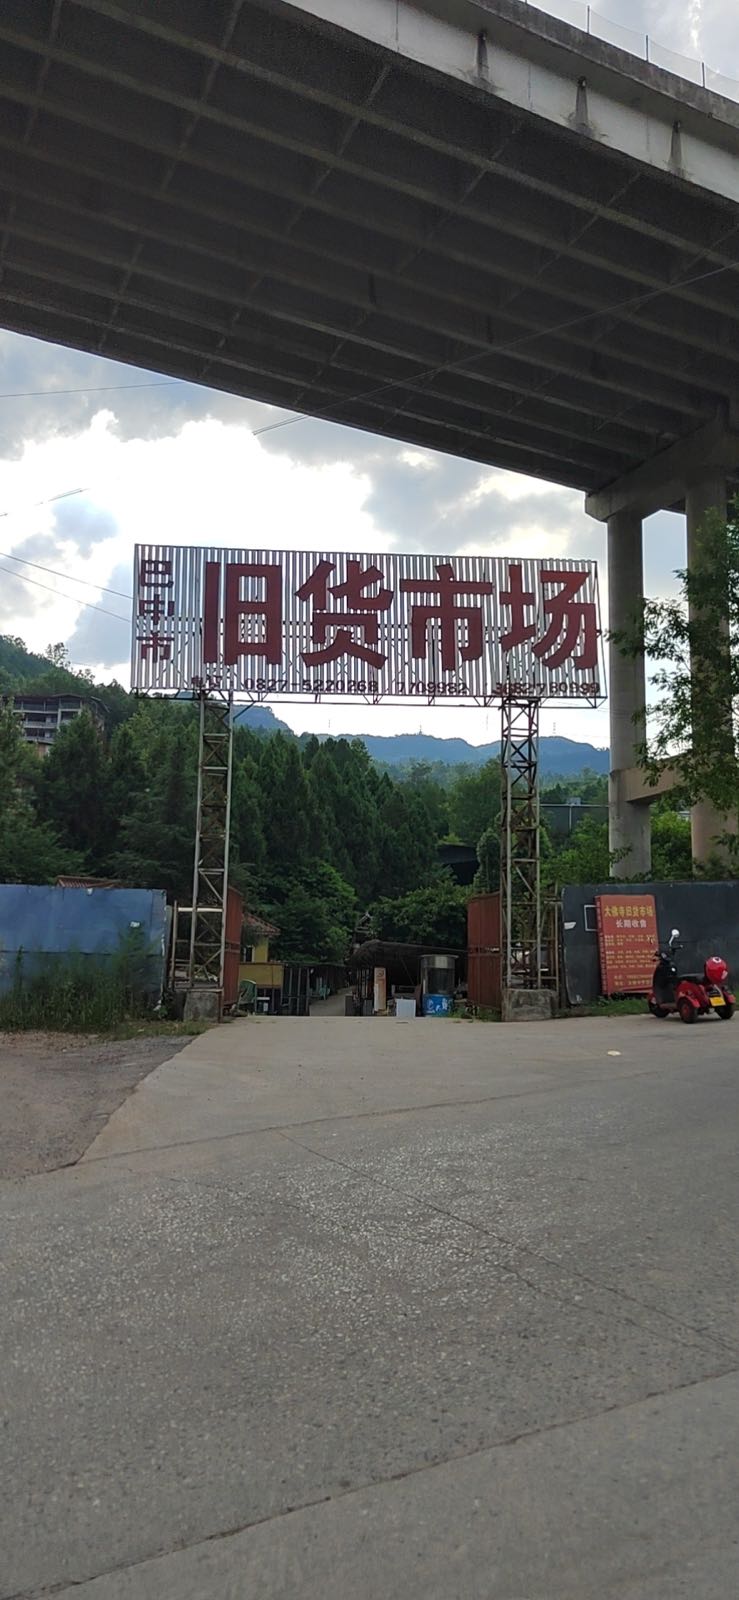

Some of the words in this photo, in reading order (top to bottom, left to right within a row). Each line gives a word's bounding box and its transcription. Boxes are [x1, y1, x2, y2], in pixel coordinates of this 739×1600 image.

[135, 559, 175, 663] 巴中市
[202, 559, 598, 671] 旧货市场
